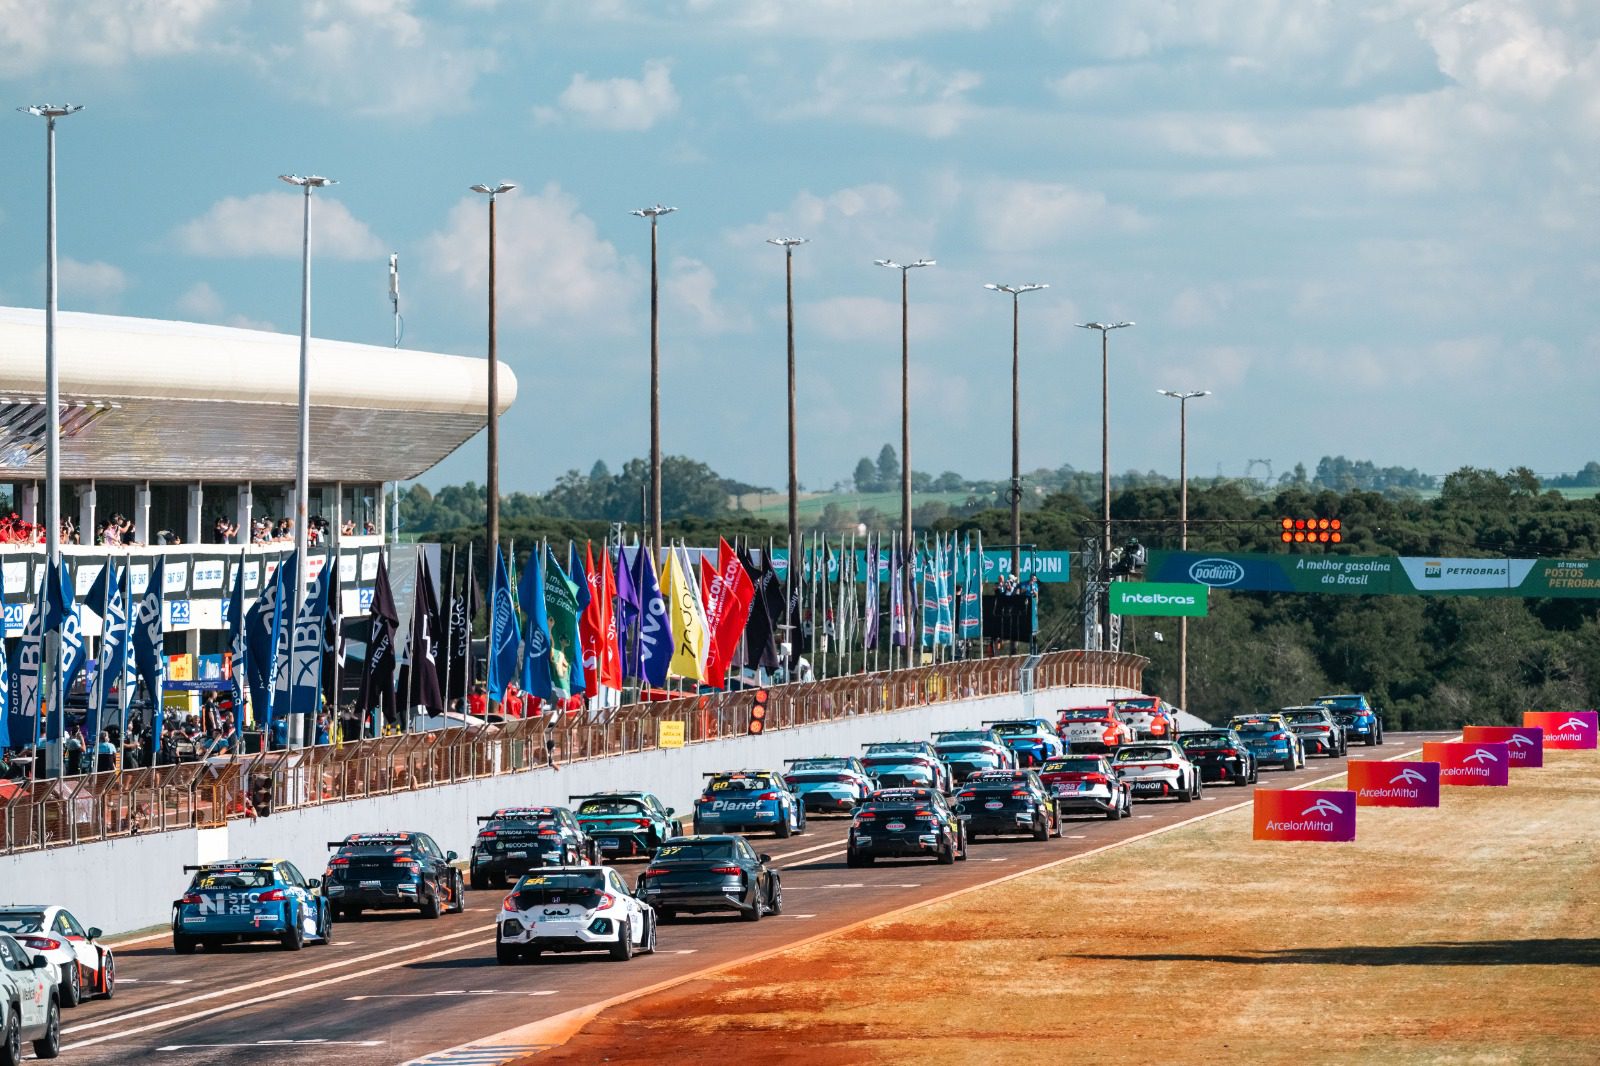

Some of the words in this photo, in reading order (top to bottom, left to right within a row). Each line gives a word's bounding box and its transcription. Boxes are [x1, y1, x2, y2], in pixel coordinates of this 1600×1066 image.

[1296, 559, 1304, 569] A
[1306, 561, 1342, 571] melhor
[1345, 562, 1390, 575] gasolina
[1446, 567, 1507, 576] PETROBRAS
[1195, 566, 1237, 580] podium
[1544, 568, 1584, 578] POSTOS
[1321, 575, 1334, 585] do
[1337, 575, 1369, 586] Brasil
[1549, 578, 1600, 589] PETROBRA
[361, 589, 375, 604] 27
[1122, 593, 1195, 604] intelbras
[4, 605, 23, 622] 20
[172, 602, 190, 618] 23
[1543, 733, 1582, 742] celorMittal
[1440, 767, 1490, 777] rcelorMittal
[712, 781, 729, 791] 60
[1359, 788, 1418, 798] ArcelorMittal
[712, 800, 762, 812] Planet
[1266, 821, 1334, 832] ArcelorMittal
[200, 877, 216, 888] 15
[229, 904, 250, 915] RE
